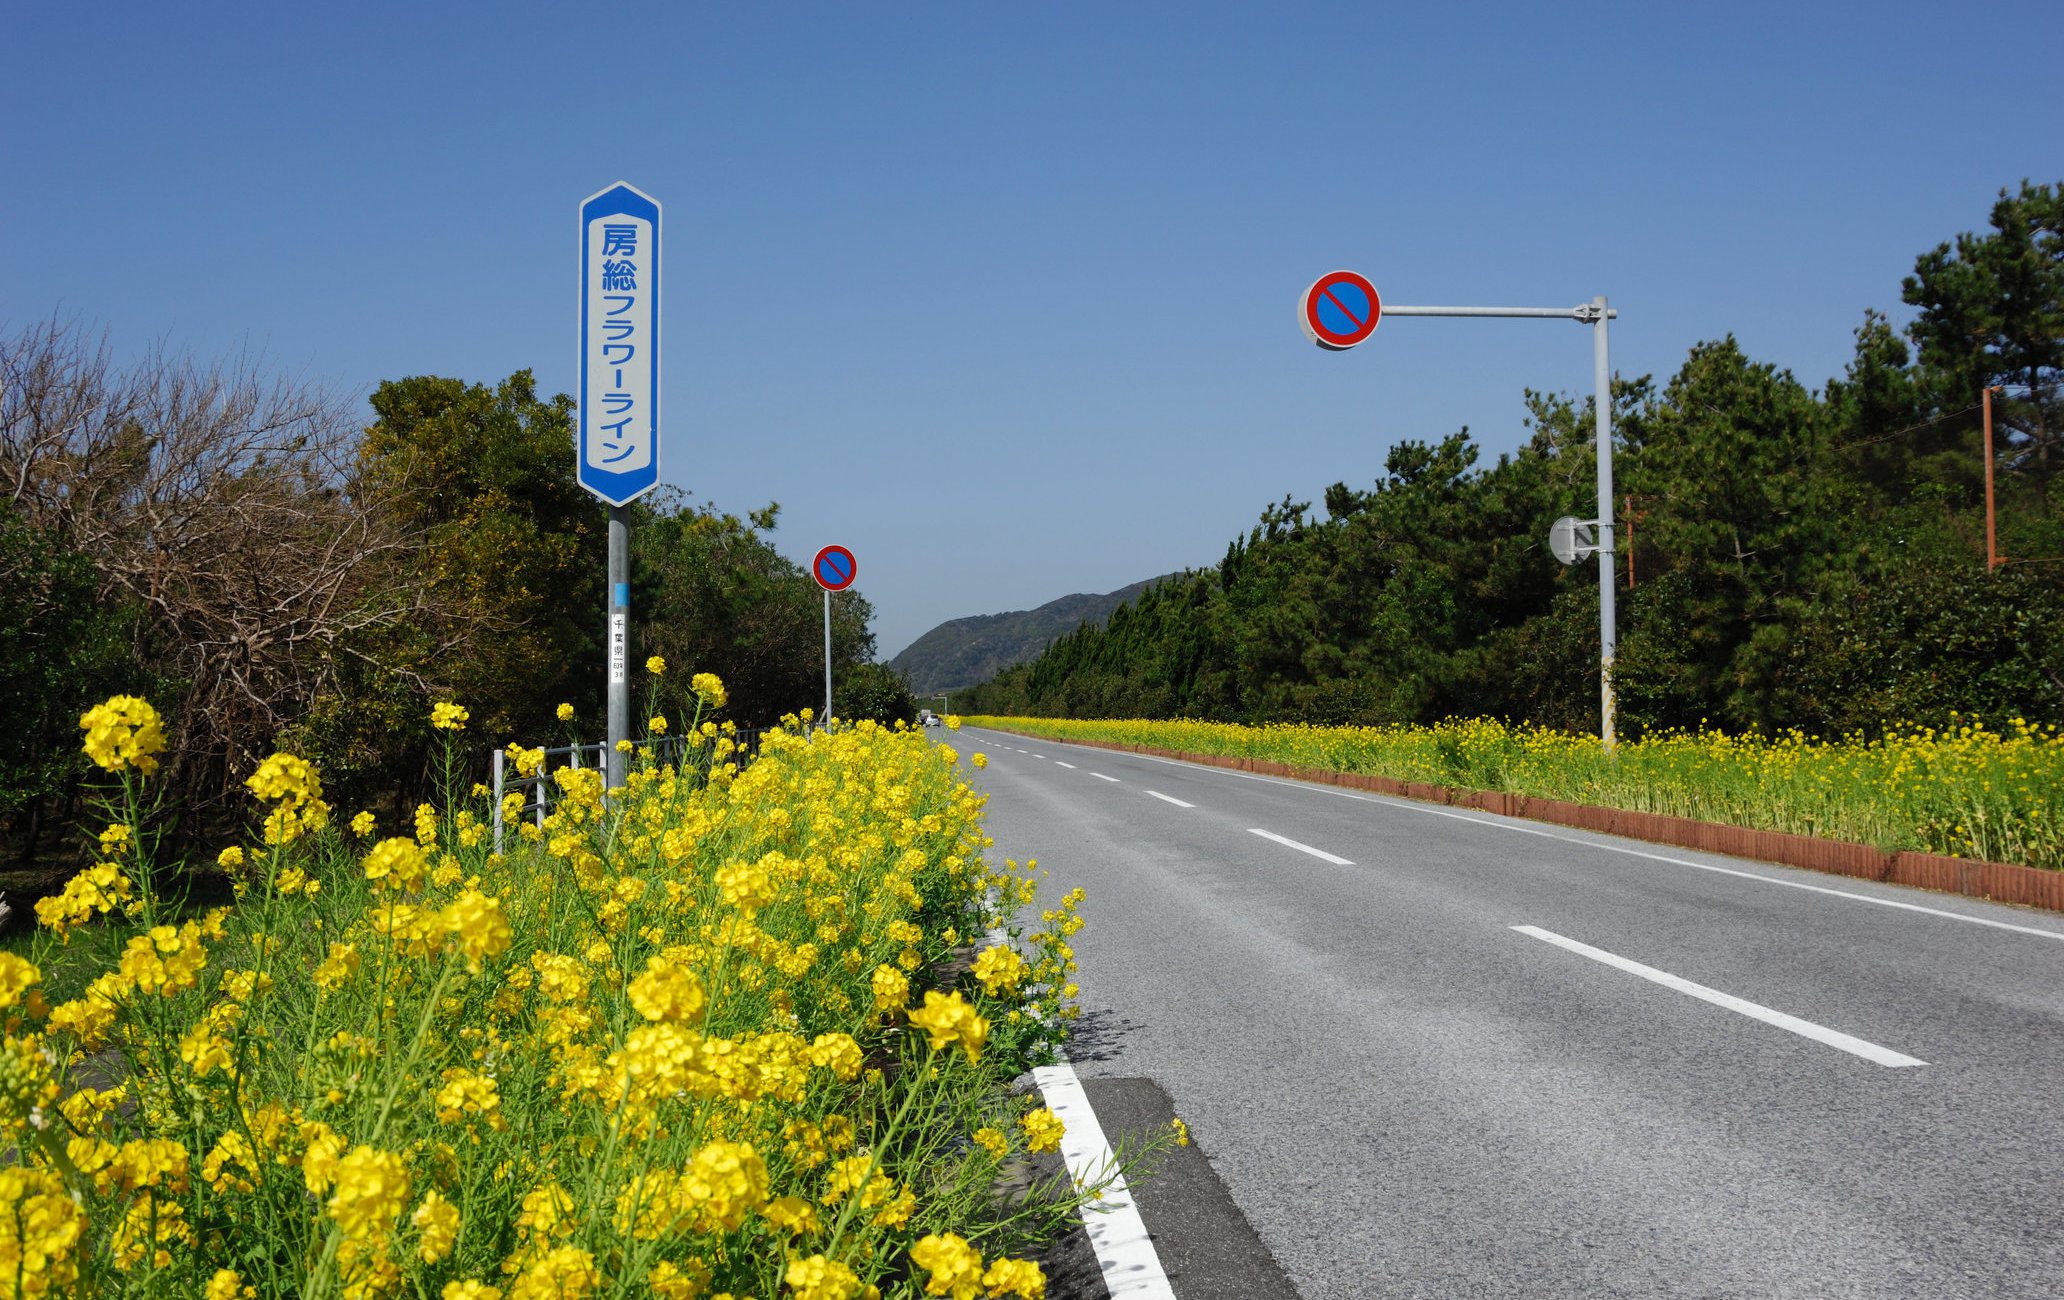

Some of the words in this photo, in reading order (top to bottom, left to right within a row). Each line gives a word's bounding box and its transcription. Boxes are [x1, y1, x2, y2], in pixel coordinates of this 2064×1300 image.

[600, 224, 638, 464] 房総フラワーライン
